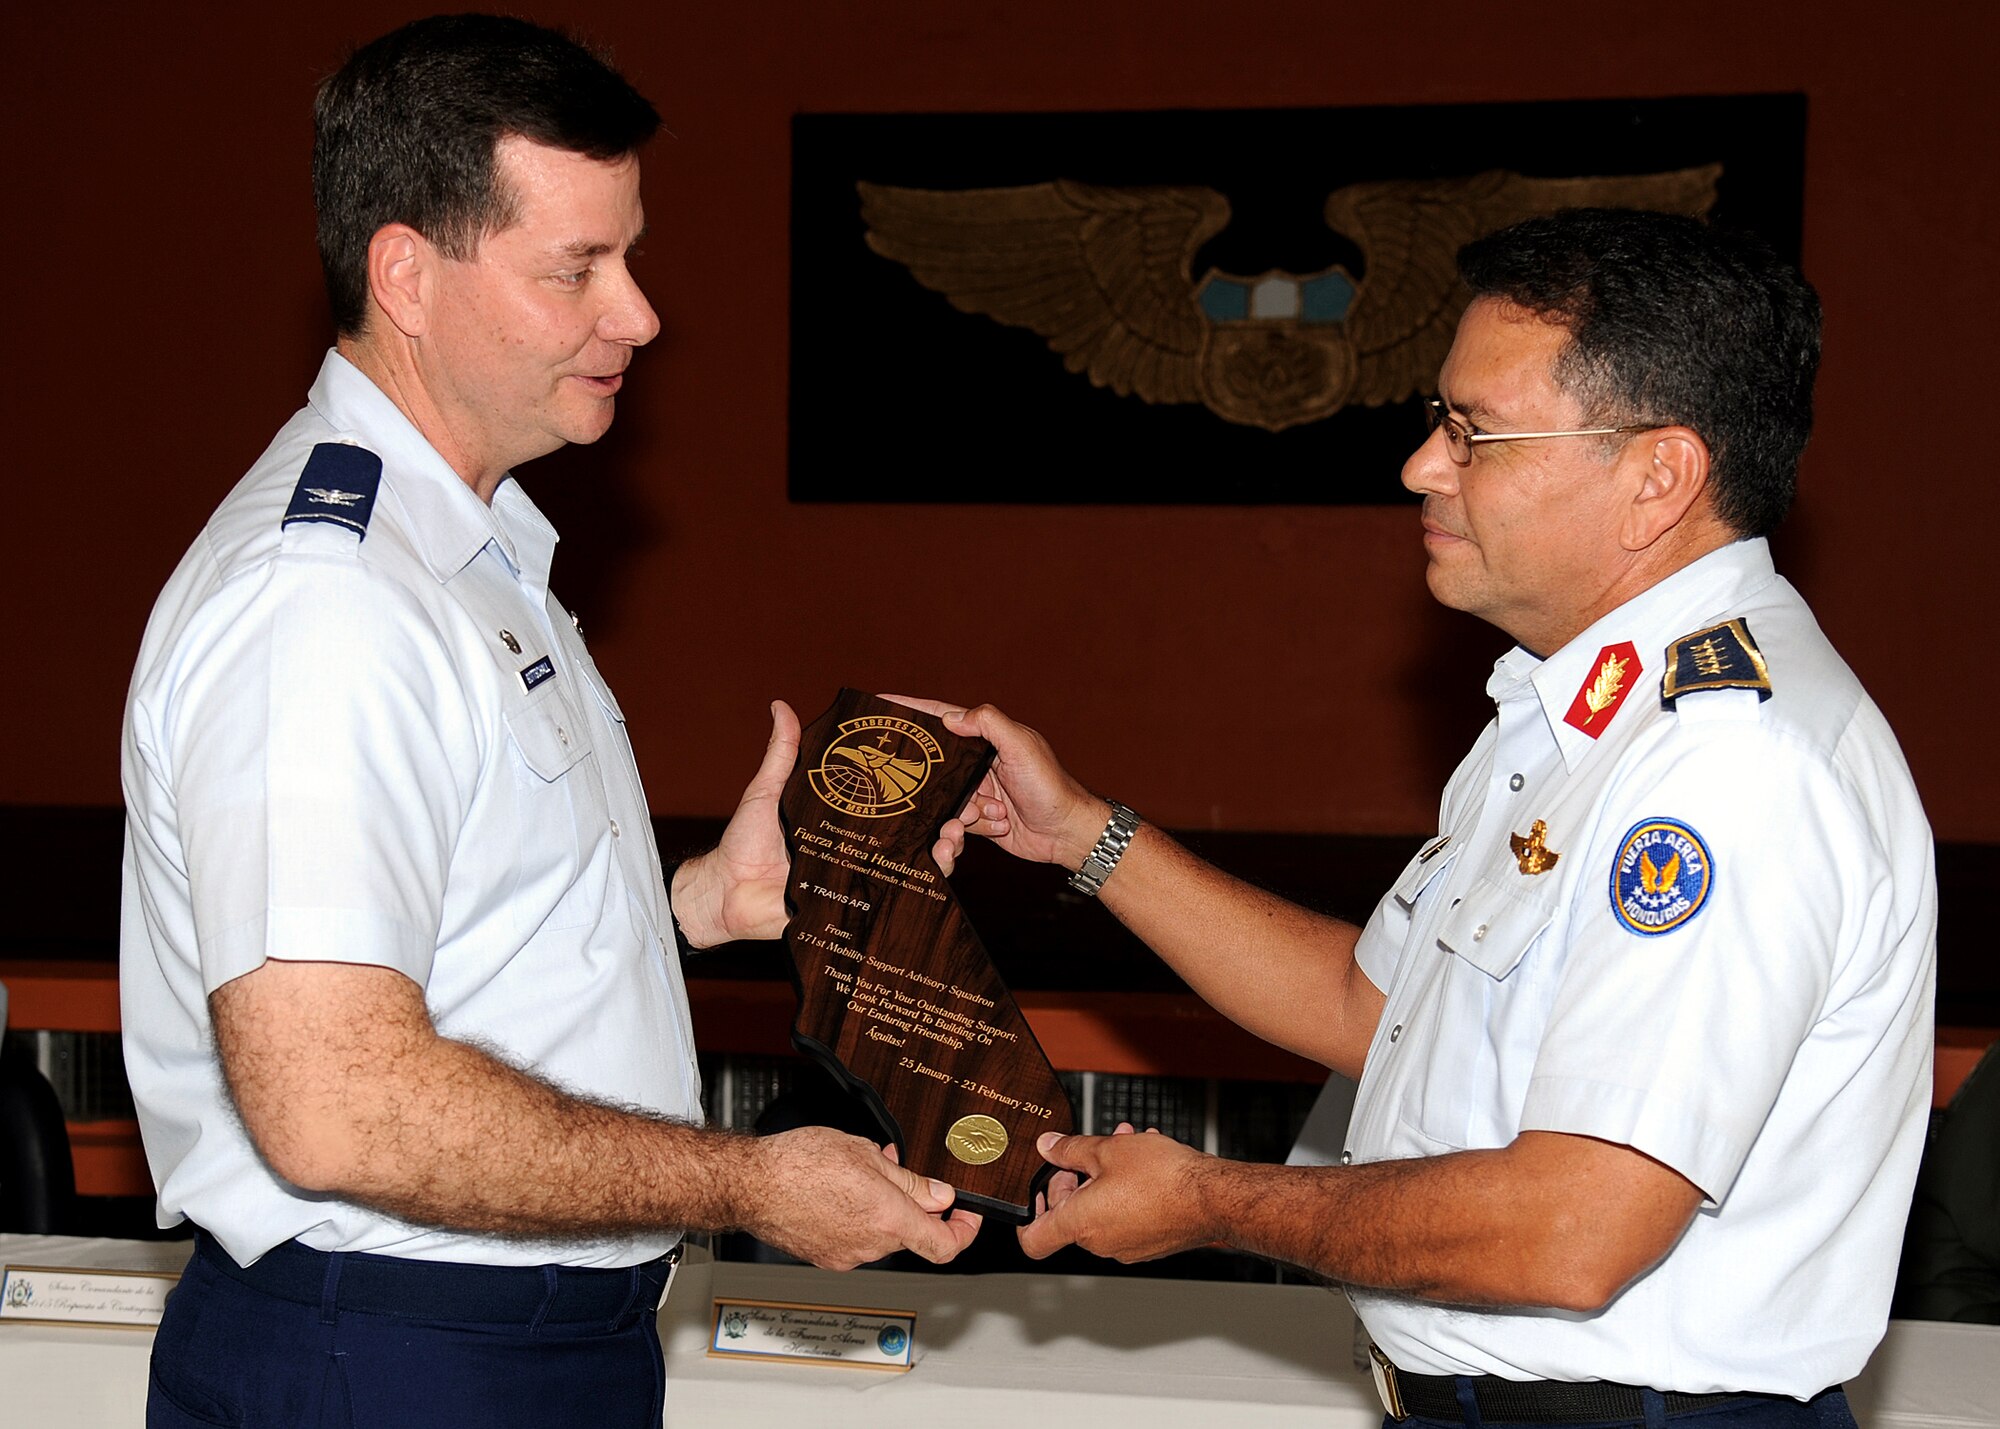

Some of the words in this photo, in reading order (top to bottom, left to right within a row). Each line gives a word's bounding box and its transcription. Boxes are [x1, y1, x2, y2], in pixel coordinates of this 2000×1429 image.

[854, 719, 891, 729] SABER
[895, 722, 908, 731] ES
[910, 728, 937, 754] PODER
[824, 794, 842, 806] 571
[846, 804, 877, 815] MSAS
[820, 820, 866, 842] Presented
[869, 836, 882, 848] To:
[795, 827, 832, 848] Fuerza
[839, 842, 869, 860] Aérea
[871, 852, 935, 883] Hondureña
[799, 845, 817, 856] Base
[818, 851, 839, 865] Aérea
[842, 860, 869, 875] Coronel
[871, 870, 898, 885] Hernán
[900, 880, 924, 894] Acosta
[1621, 831, 1661, 874] FUERZA
[1664, 833, 1703, 875] AEREA
[813, 886, 849, 904] TRAVIS
[850, 898, 871, 911] AFB
[1624, 897, 1691, 924] HONDURAS
[824, 923, 852, 940] From:
[797, 932, 826, 949] 571st
[826, 942, 866, 963] Mobility
[866, 956, 906, 977] Support
[906, 970, 948, 992] Advisory
[948, 985, 994, 1008] Squadron
[824, 966, 852, 983] Thank
[856, 976, 872, 990] You
[874, 983, 892, 996] For
[894, 991, 916, 1005] Your
[917, 1000, 975, 1028] Outstanding
[836, 982, 850, 994] We
[852, 989, 878, 1004] Look
[878, 998, 918, 1020] Forward
[922, 1012, 932, 1024] To
[936, 1018, 976, 1040] Building
[978, 1034, 992, 1046] On
[846, 1000, 867, 1014] Our
[868, 1009, 910, 1033] Enduring
[912, 1024, 965, 1051] Friendship.
[866, 1026, 906, 1048] Águilas!
[899, 1056, 915, 1069] 25
[914, 1062, 954, 1084] January
[960, 1079, 976, 1092] 23
[977, 1085, 1022, 1110] February
[1022, 1101, 1052, 1119] 2012
[746, 1309, 776, 1323] Señor
[780, 1310, 840, 1328] Comandante
[843, 1317, 886, 1332] General
[763, 1328, 773, 1336] de
[775, 1328, 784, 1338] la
[787, 1327, 828, 1343] Fuerza
